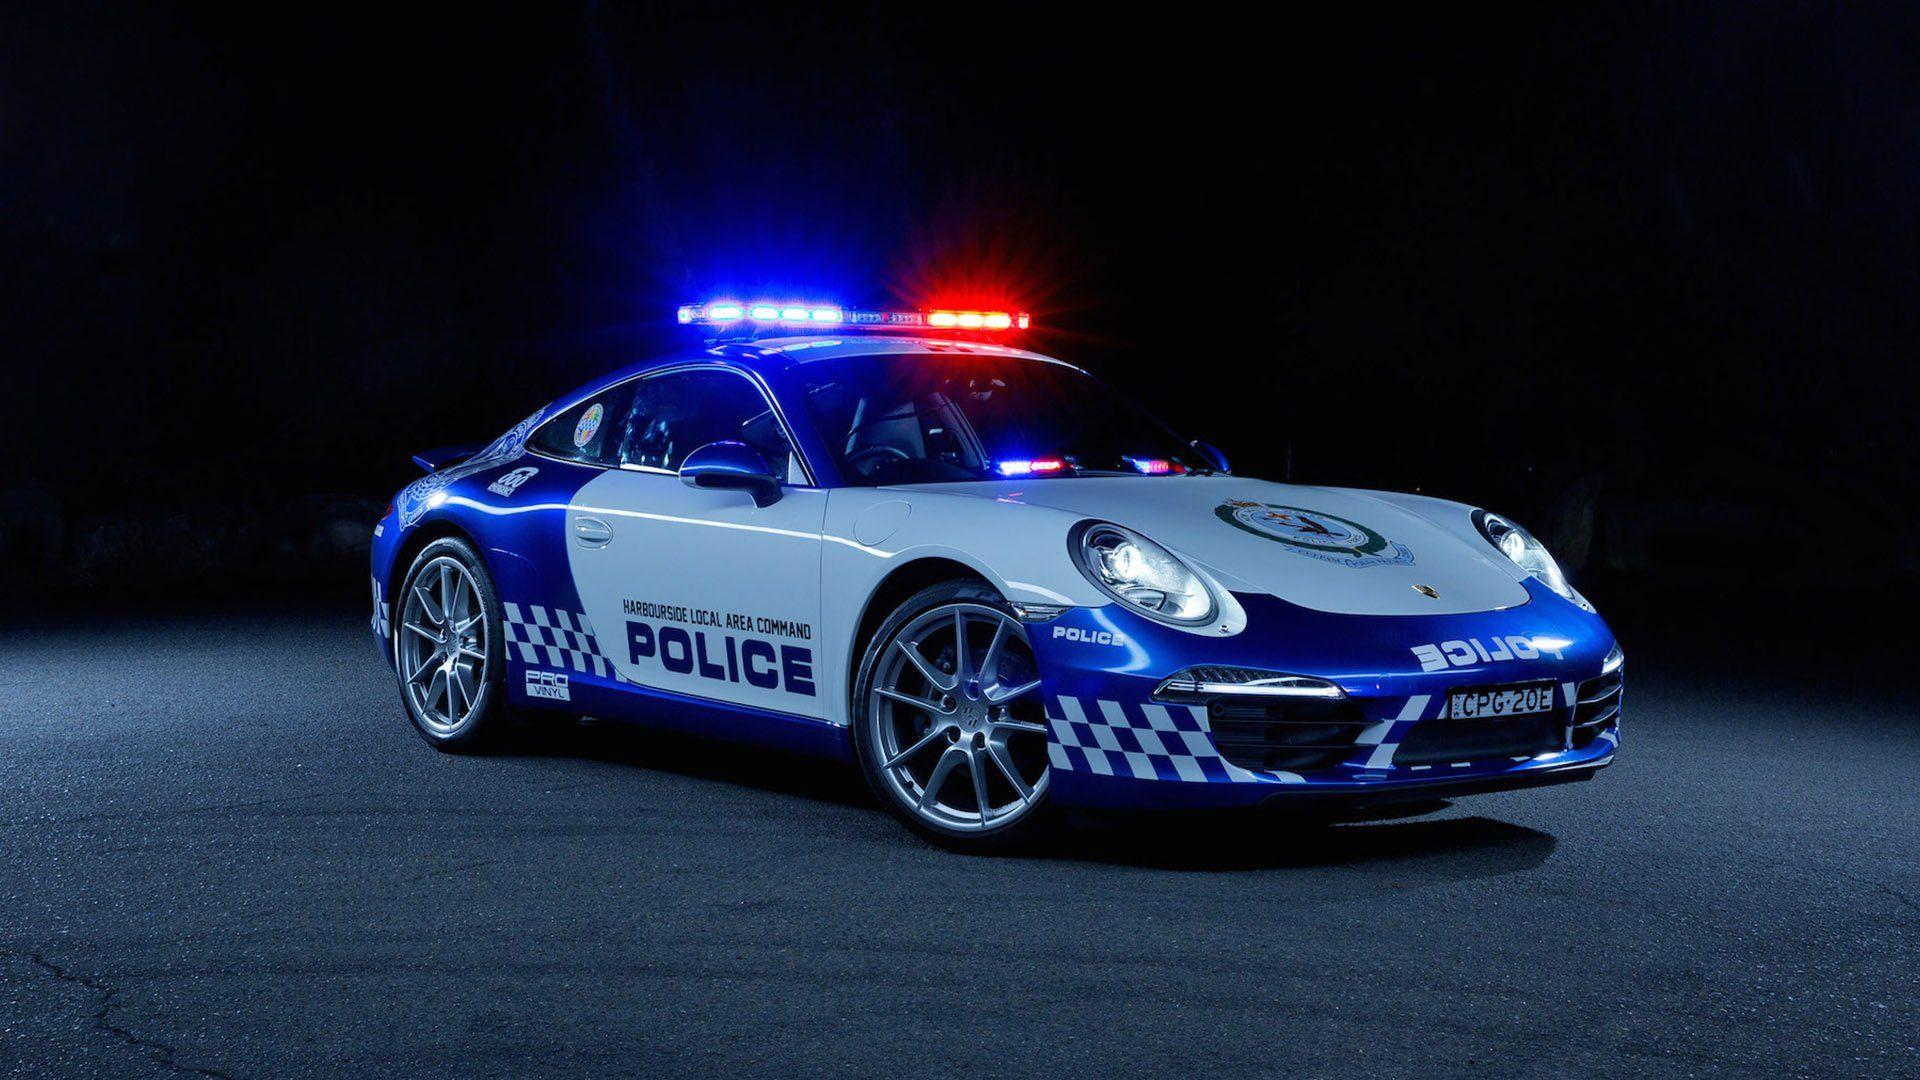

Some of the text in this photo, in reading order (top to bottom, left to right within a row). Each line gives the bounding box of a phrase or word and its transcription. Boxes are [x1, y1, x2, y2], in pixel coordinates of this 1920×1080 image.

[623, 599, 812, 640] HARBOURSIDE LOCAL AREA COMMAND
[1053, 626, 1125, 647] POLICE
[626, 620, 816, 697] POLICE
[526, 670, 569, 688] PRO
[533, 685, 565, 699] VINYL
